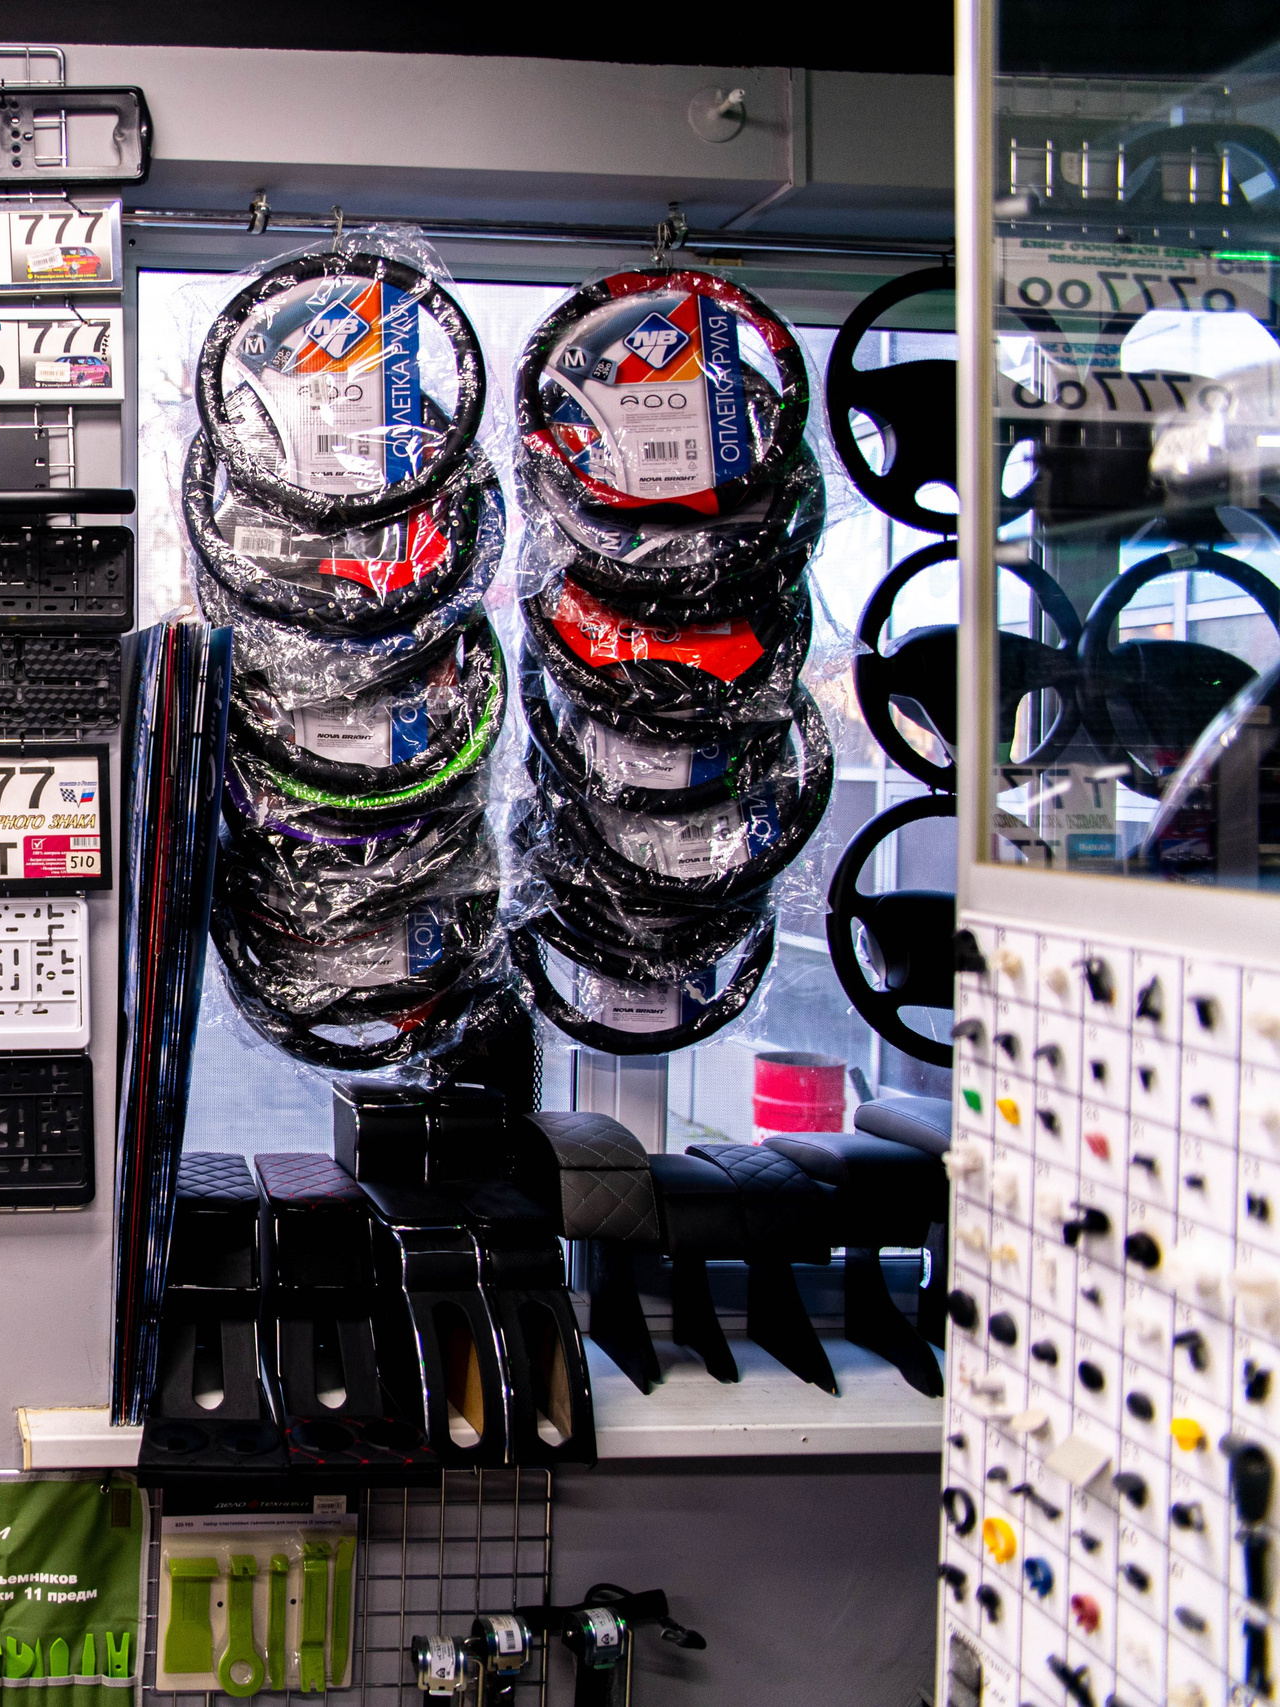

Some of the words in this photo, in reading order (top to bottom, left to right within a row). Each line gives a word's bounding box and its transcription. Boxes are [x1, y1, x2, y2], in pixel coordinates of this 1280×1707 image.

[19, 212, 103, 244] 777
[27, 321, 111, 353] 777
[632, 329, 679, 346] NB
[709, 317, 731, 363] РУЛЯ
[564, 350, 585, 367] M
[715, 368, 740, 462] ОПЛЕТКА
[48, 813, 96, 829] ЗНАКА
[70, 855, 95, 869] 510
[679, 857, 701, 865] NOVA
[24, 1587, 42, 1600] 11
[47, 1588, 98, 1603] предм
